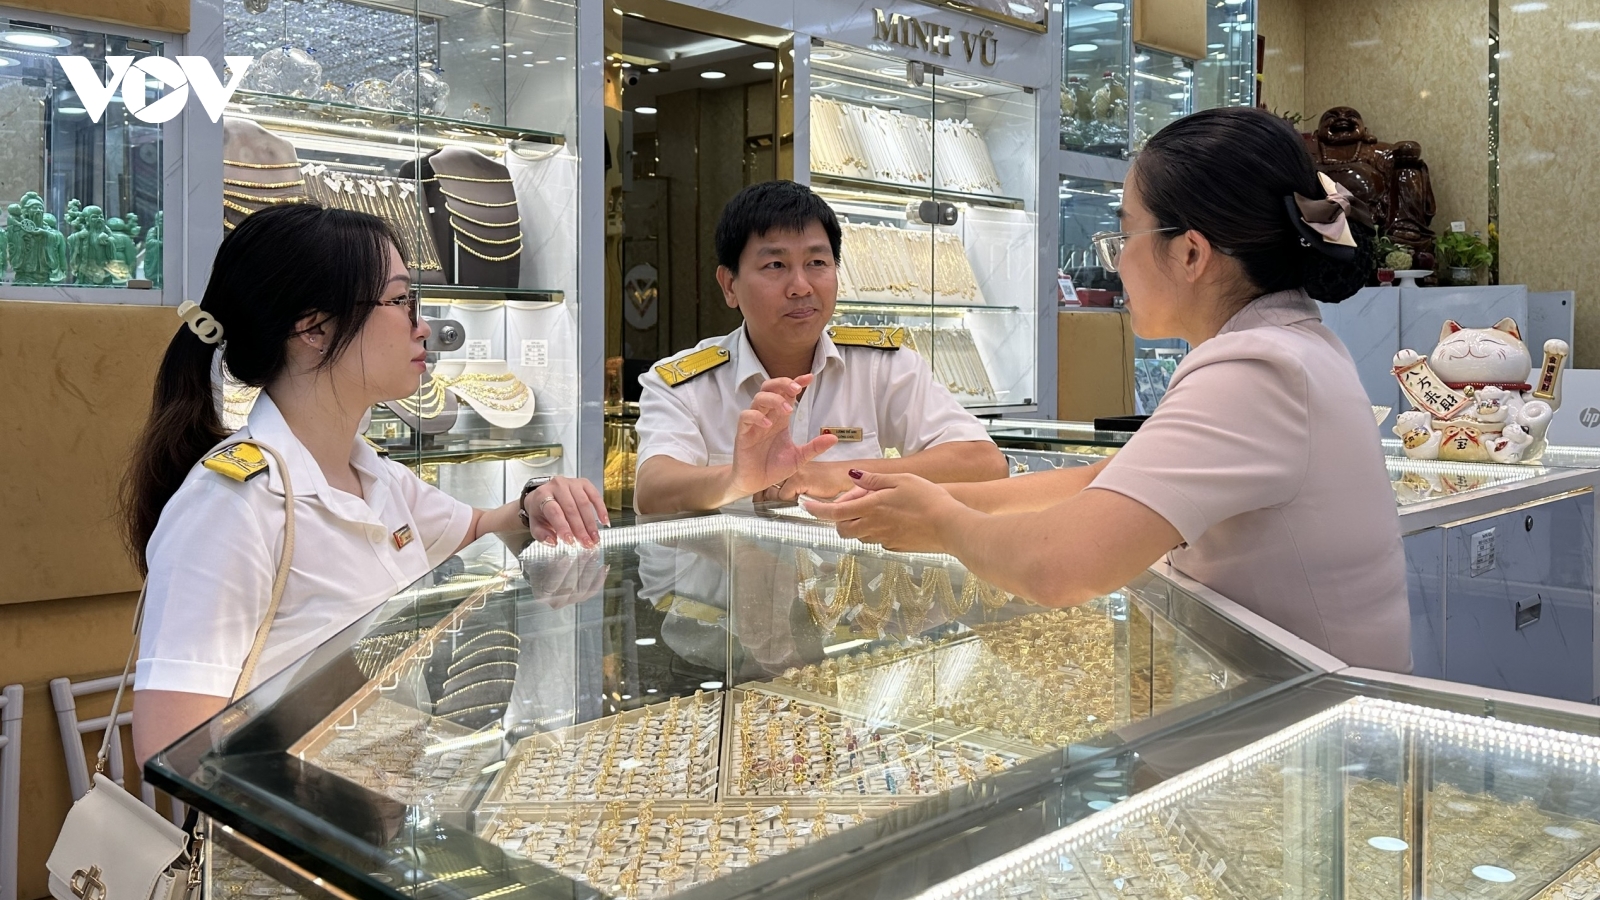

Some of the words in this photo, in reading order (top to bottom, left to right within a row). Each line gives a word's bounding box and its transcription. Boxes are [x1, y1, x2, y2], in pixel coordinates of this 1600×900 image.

[872, 8, 952, 57] MINH
[959, 26, 998, 67] VŨ
[1580, 407, 1600, 429] hp
[1453, 437, 1469, 450] 宝
